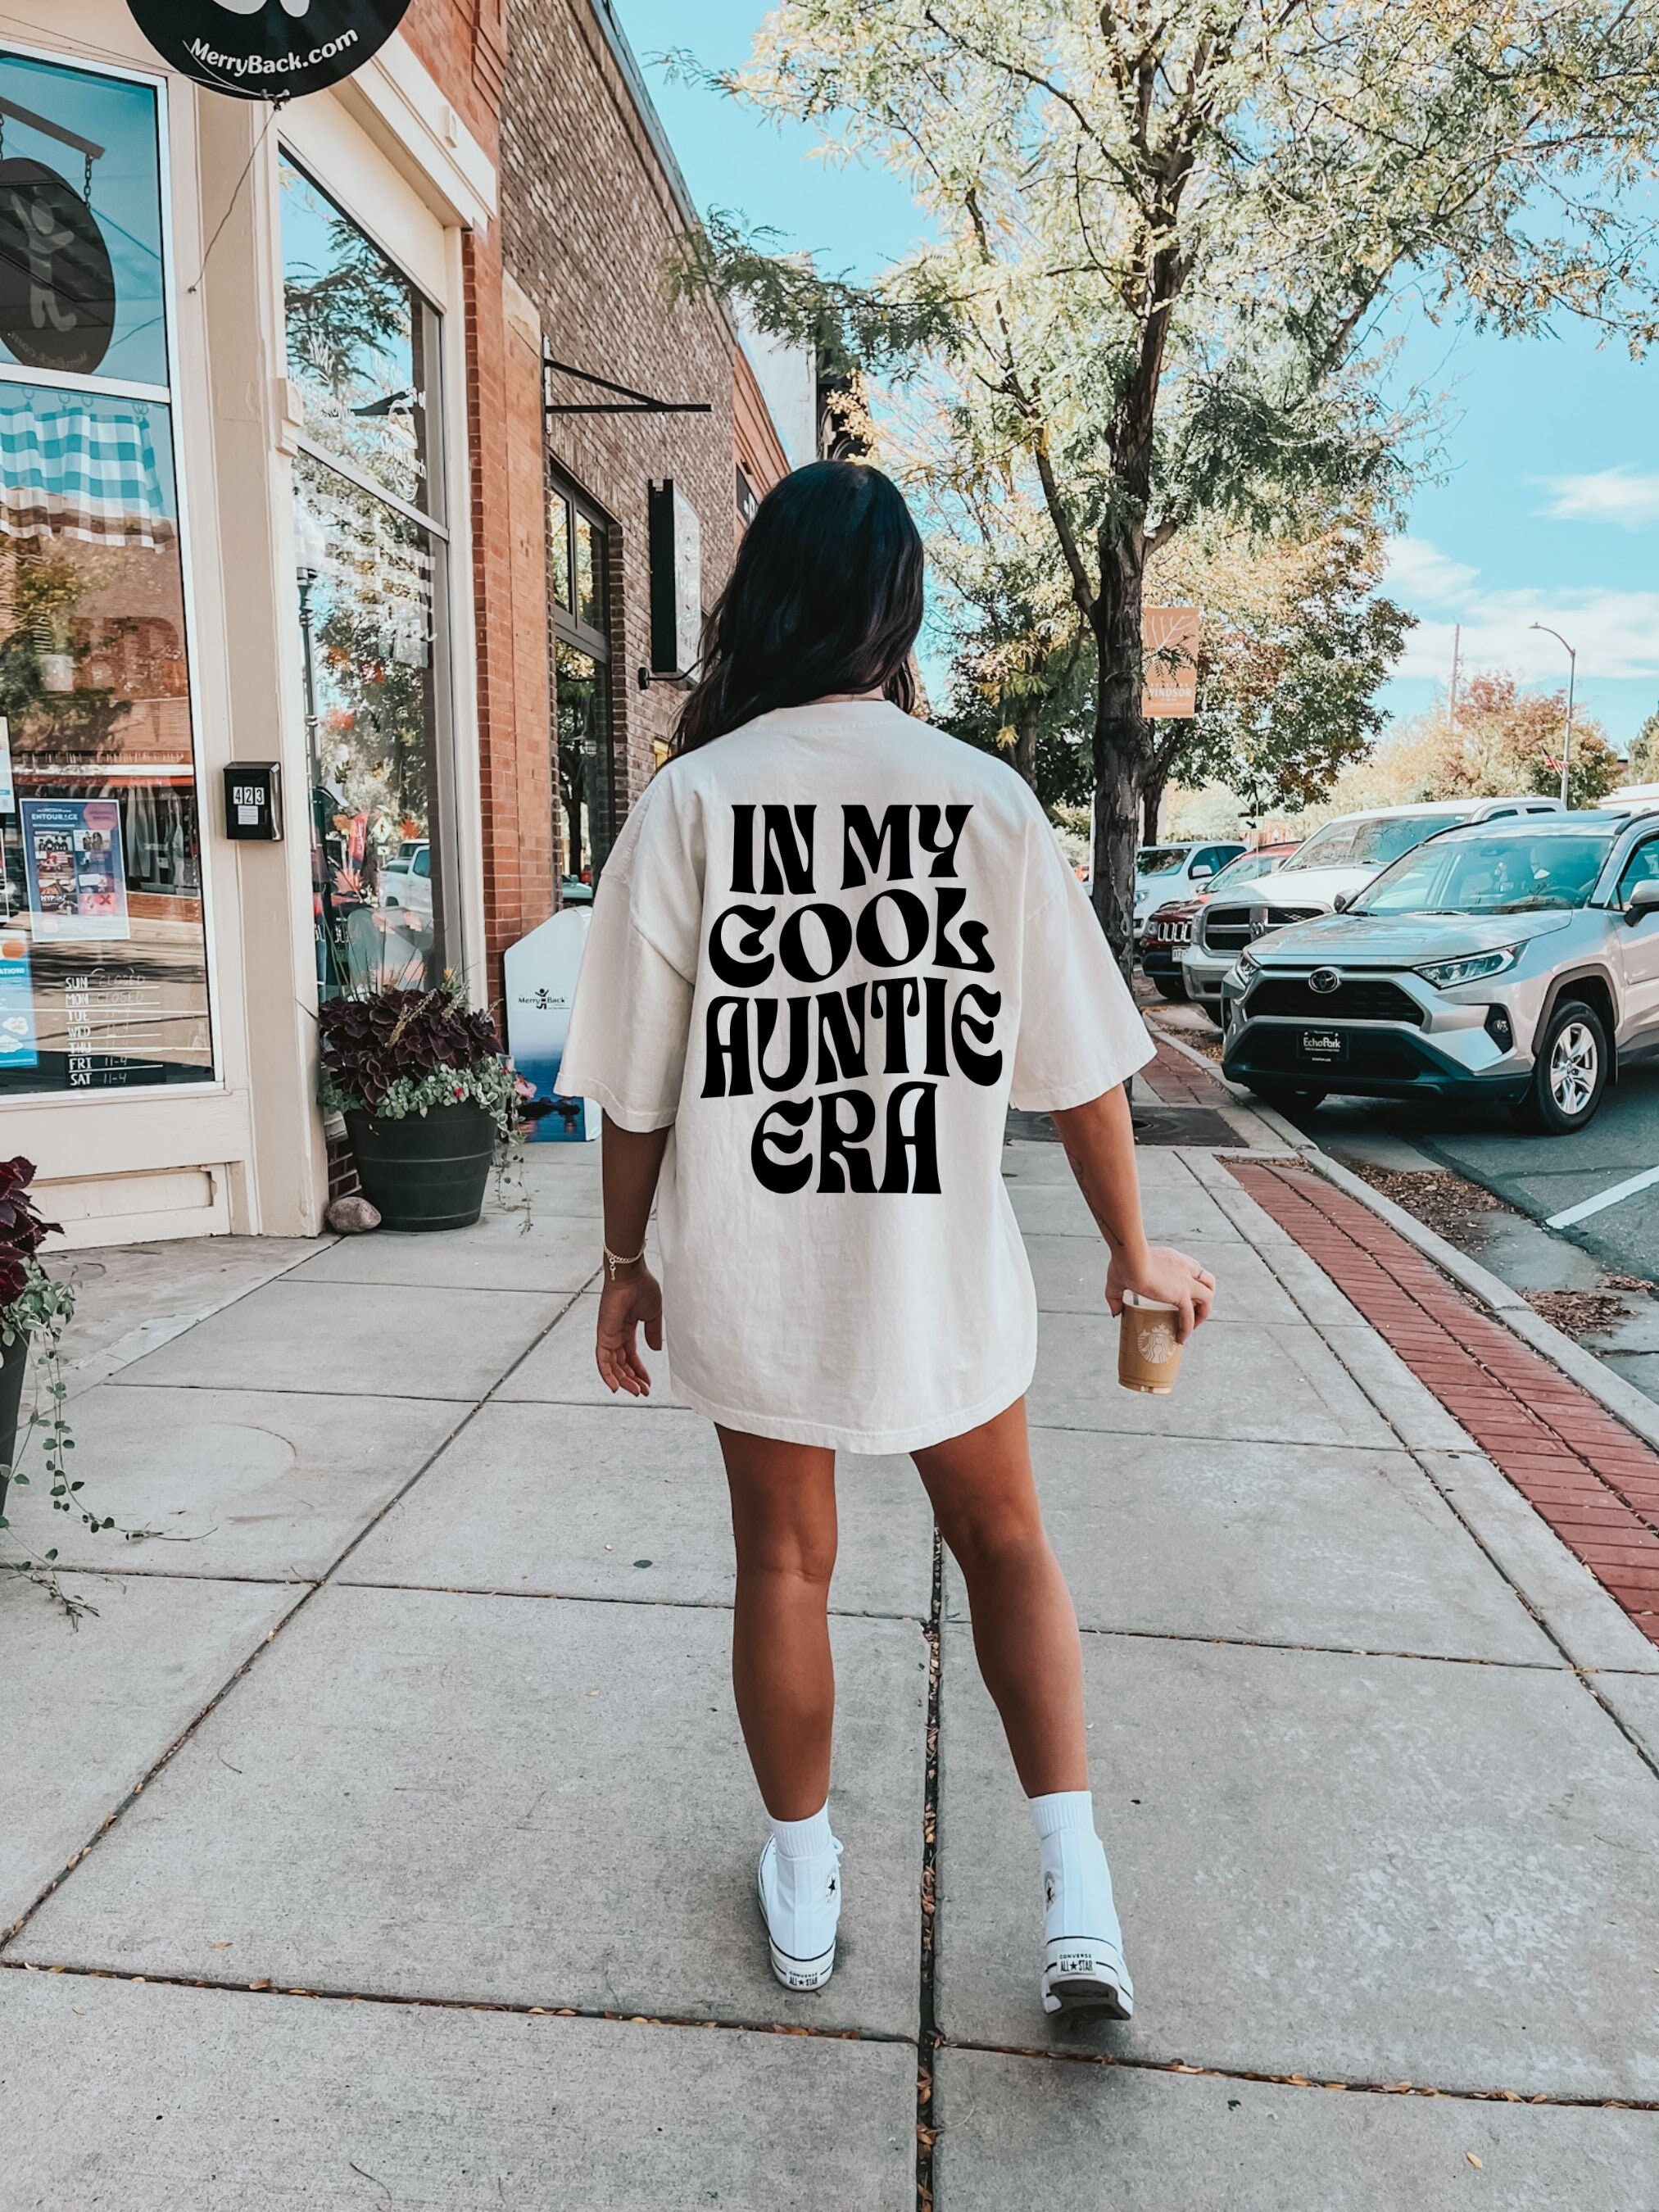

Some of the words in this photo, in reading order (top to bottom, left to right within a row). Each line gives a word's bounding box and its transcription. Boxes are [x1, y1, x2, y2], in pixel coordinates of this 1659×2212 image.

[190, 29, 359, 78] MerryBack.com
[234, 787, 263, 804] 423
[729, 805, 818, 895] IN
[841, 805, 974, 891] MY
[709, 887, 995, 989] COOL
[66, 977, 88, 989] SUN
[66, 993, 89, 1007] MON
[97, 992, 145, 1004] CLOSED
[67, 1009, 90, 1022] TUE
[67, 1026, 91, 1038] WED
[700, 977, 1003, 1099] AUNTIE
[68, 1042, 92, 1054] THU
[1303, 1037, 1341, 1048] EchoPark
[69, 1058, 92, 1070] FRI
[70, 1073, 93, 1086] SAT
[750, 1081, 942, 1194] ERA
